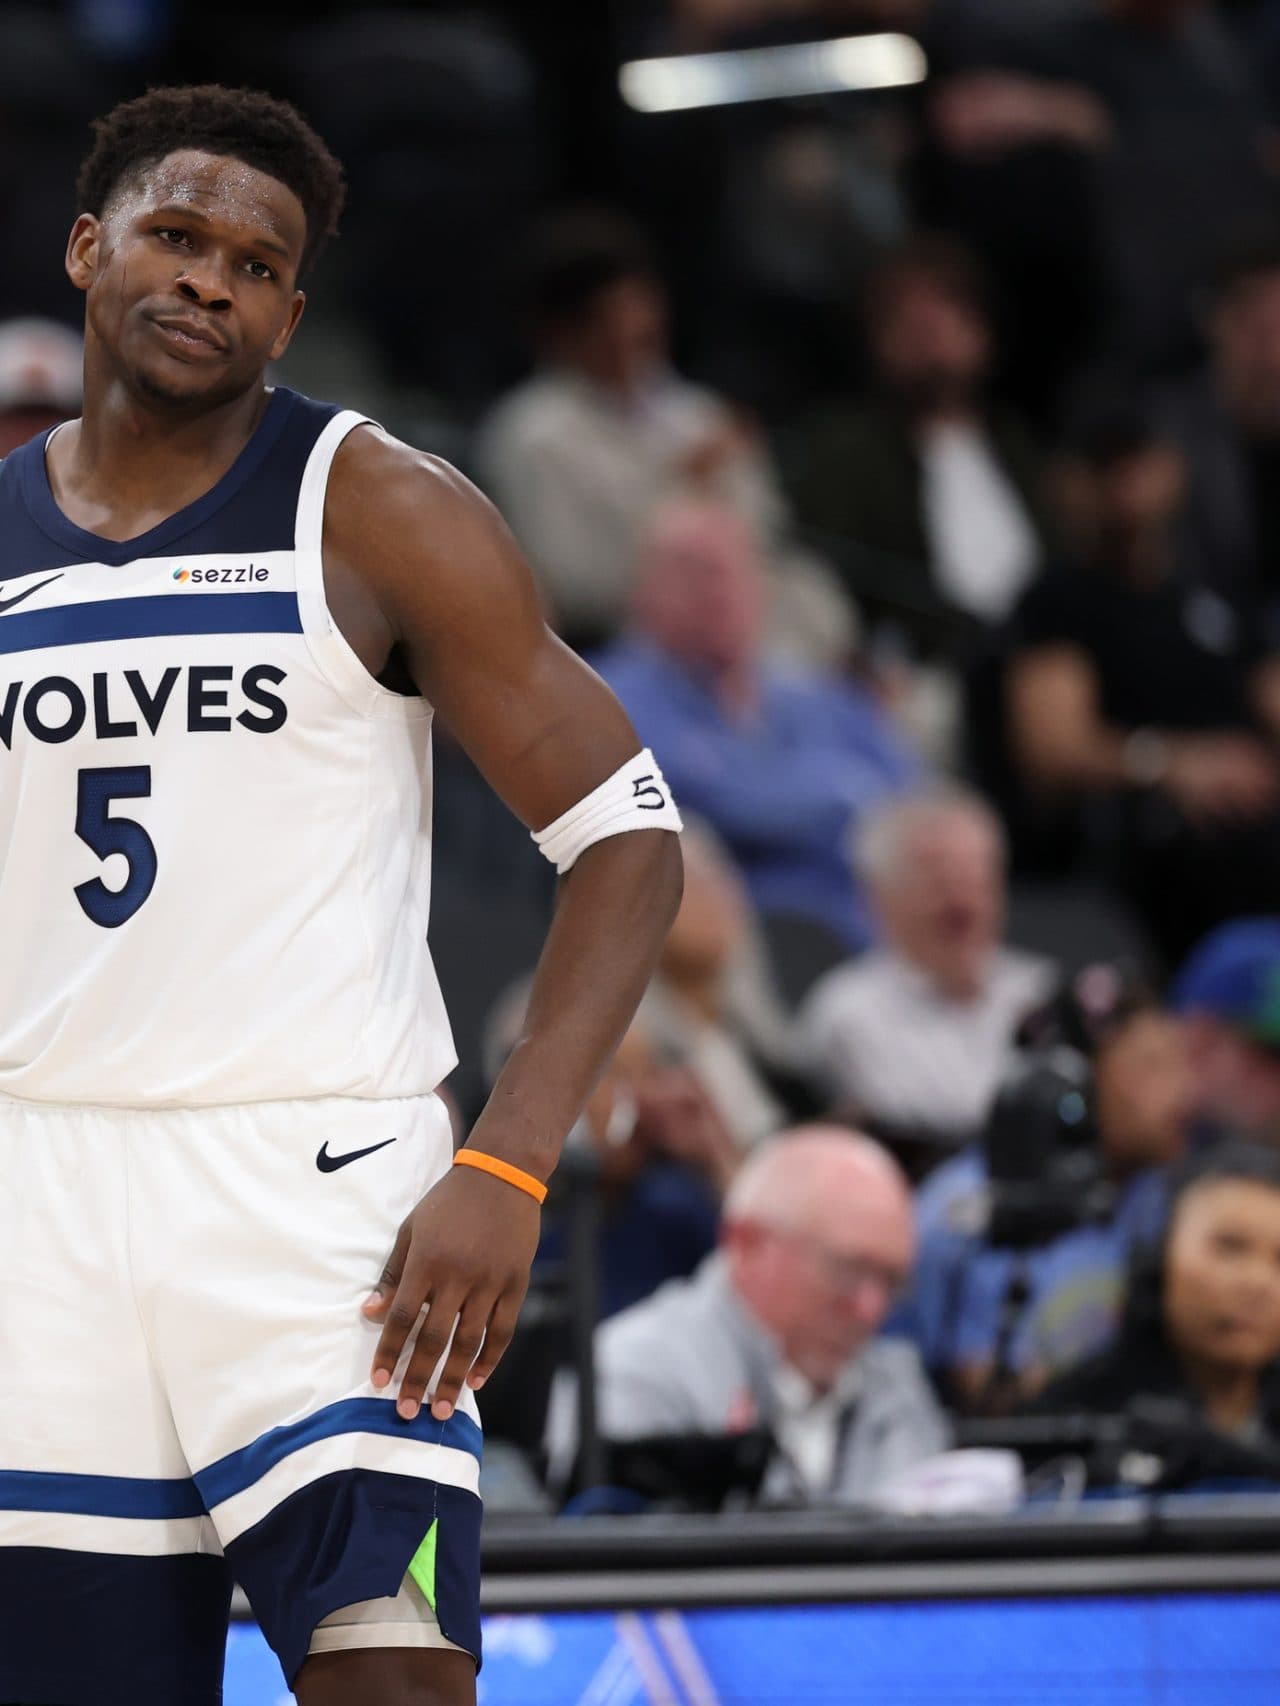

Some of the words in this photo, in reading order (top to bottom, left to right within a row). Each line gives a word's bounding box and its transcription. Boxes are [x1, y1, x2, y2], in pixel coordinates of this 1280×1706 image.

[191, 563, 269, 583] sezzle
[632, 775, 665, 809] 5
[73, 765, 157, 929] 5
